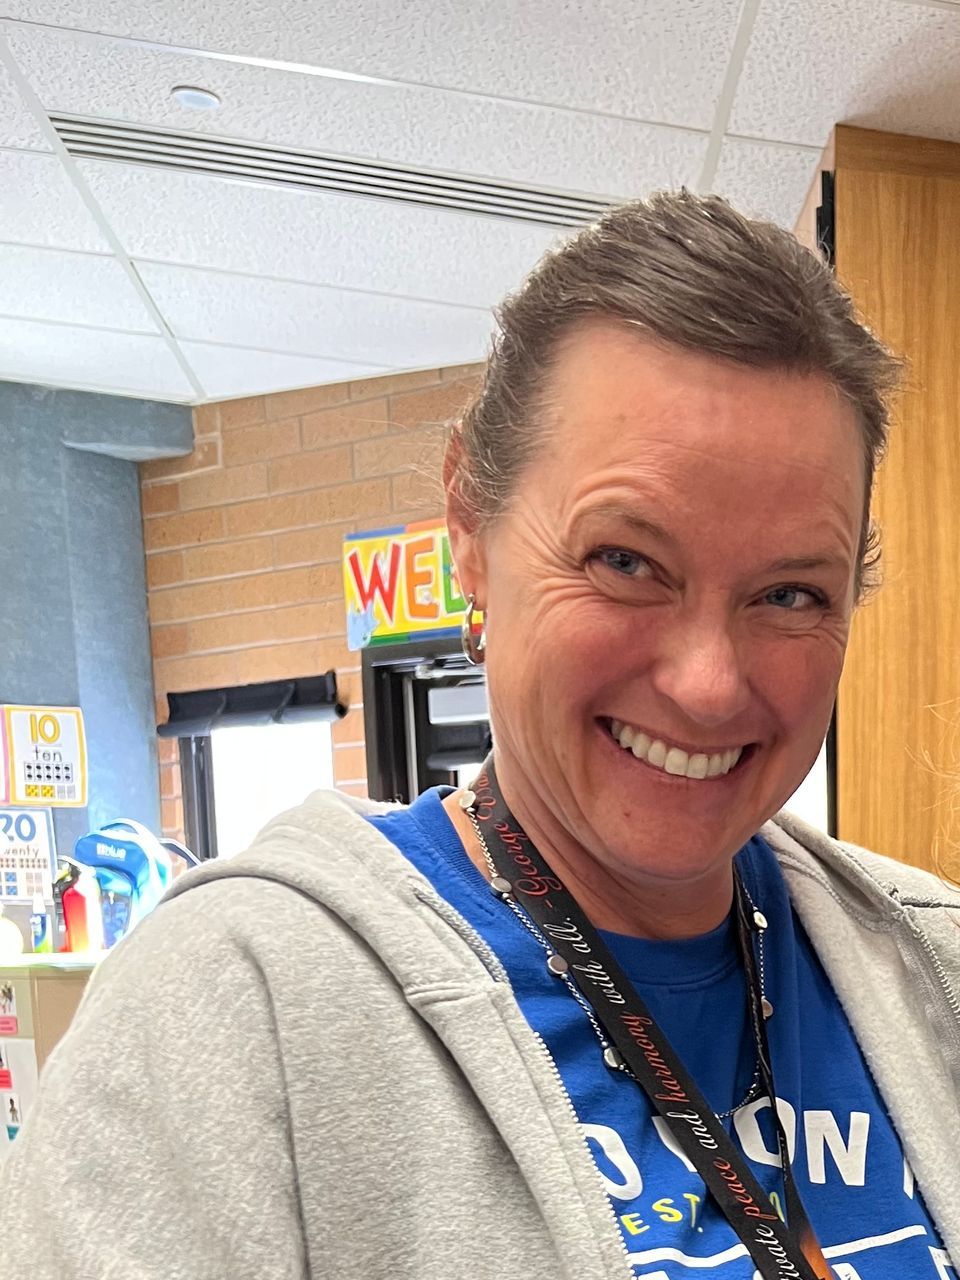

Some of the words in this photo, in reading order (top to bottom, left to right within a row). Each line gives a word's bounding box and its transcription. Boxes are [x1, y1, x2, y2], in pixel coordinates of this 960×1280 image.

[29, 714, 61, 744] 10
[34, 745, 63, 762] ten
[543, 916, 592, 954] all.
[572, 960, 626, 1006] with
[620, 1011, 690, 1104] harmony
[666, 1110, 719, 1151] and
[712, 1156, 779, 1221] peace
[620, 1193, 704, 1236] EST.
